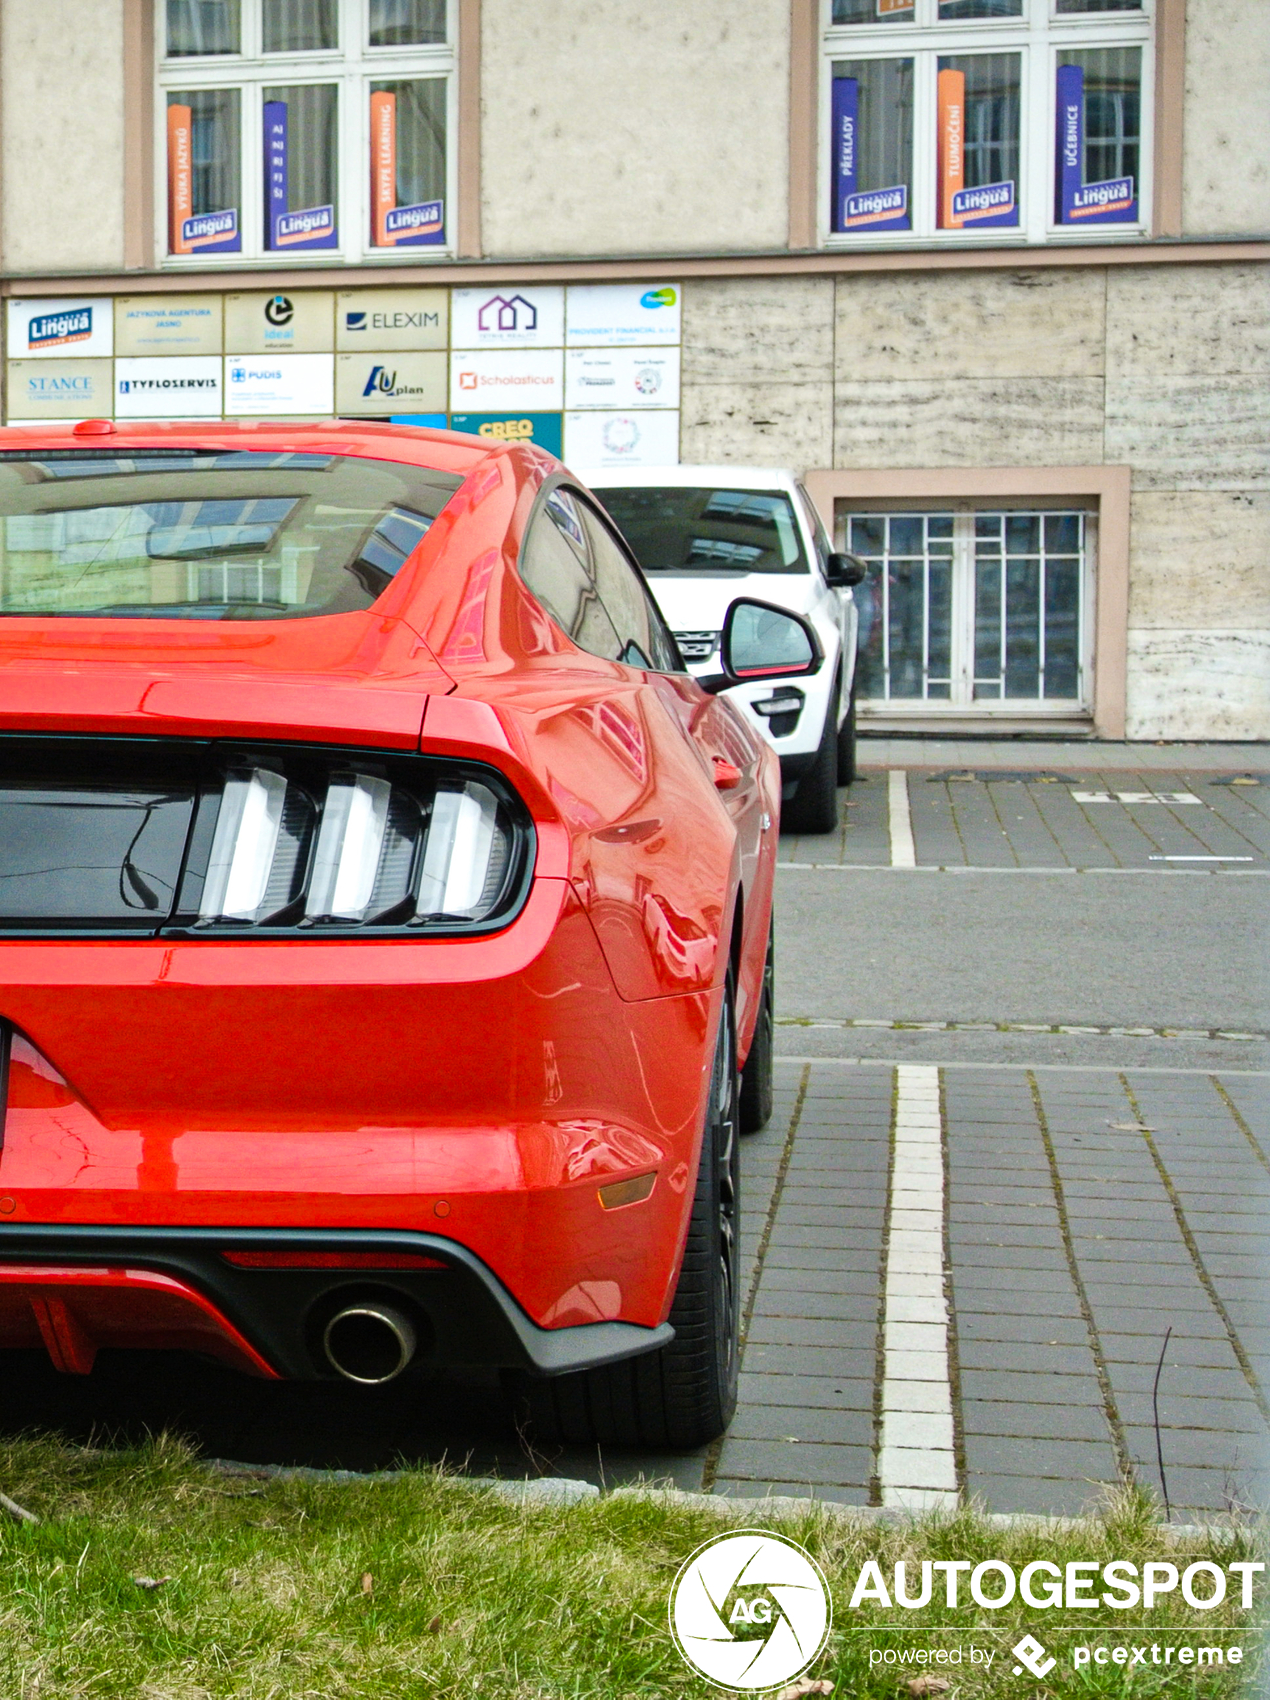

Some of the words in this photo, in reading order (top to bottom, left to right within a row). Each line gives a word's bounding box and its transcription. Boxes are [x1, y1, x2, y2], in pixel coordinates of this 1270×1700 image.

[381, 104, 392, 164] LEARNING
[947, 105, 960, 177] TLUMOČENÍ
[1064, 105, 1078, 167] UČEBNICE
[840, 115, 854, 176] PŘEKLADY
[381, 168, 392, 203] SKYPE
[1074, 185, 1128, 207] Lingua
[849, 193, 902, 215] Lingua
[956, 189, 1009, 211] Lingua
[185, 215, 233, 238] Lingua
[280, 213, 329, 234] Lingua
[388, 207, 439, 230] Lingua
[31, 314, 89, 338] Lingua
[372, 312, 438, 328] ELEXIM
[28, 377, 92, 390] STANCE
[132, 379, 217, 388] TYFLOSERVIS
[248, 370, 282, 379] PUDIS
[480, 375, 555, 386] Scholasticus
